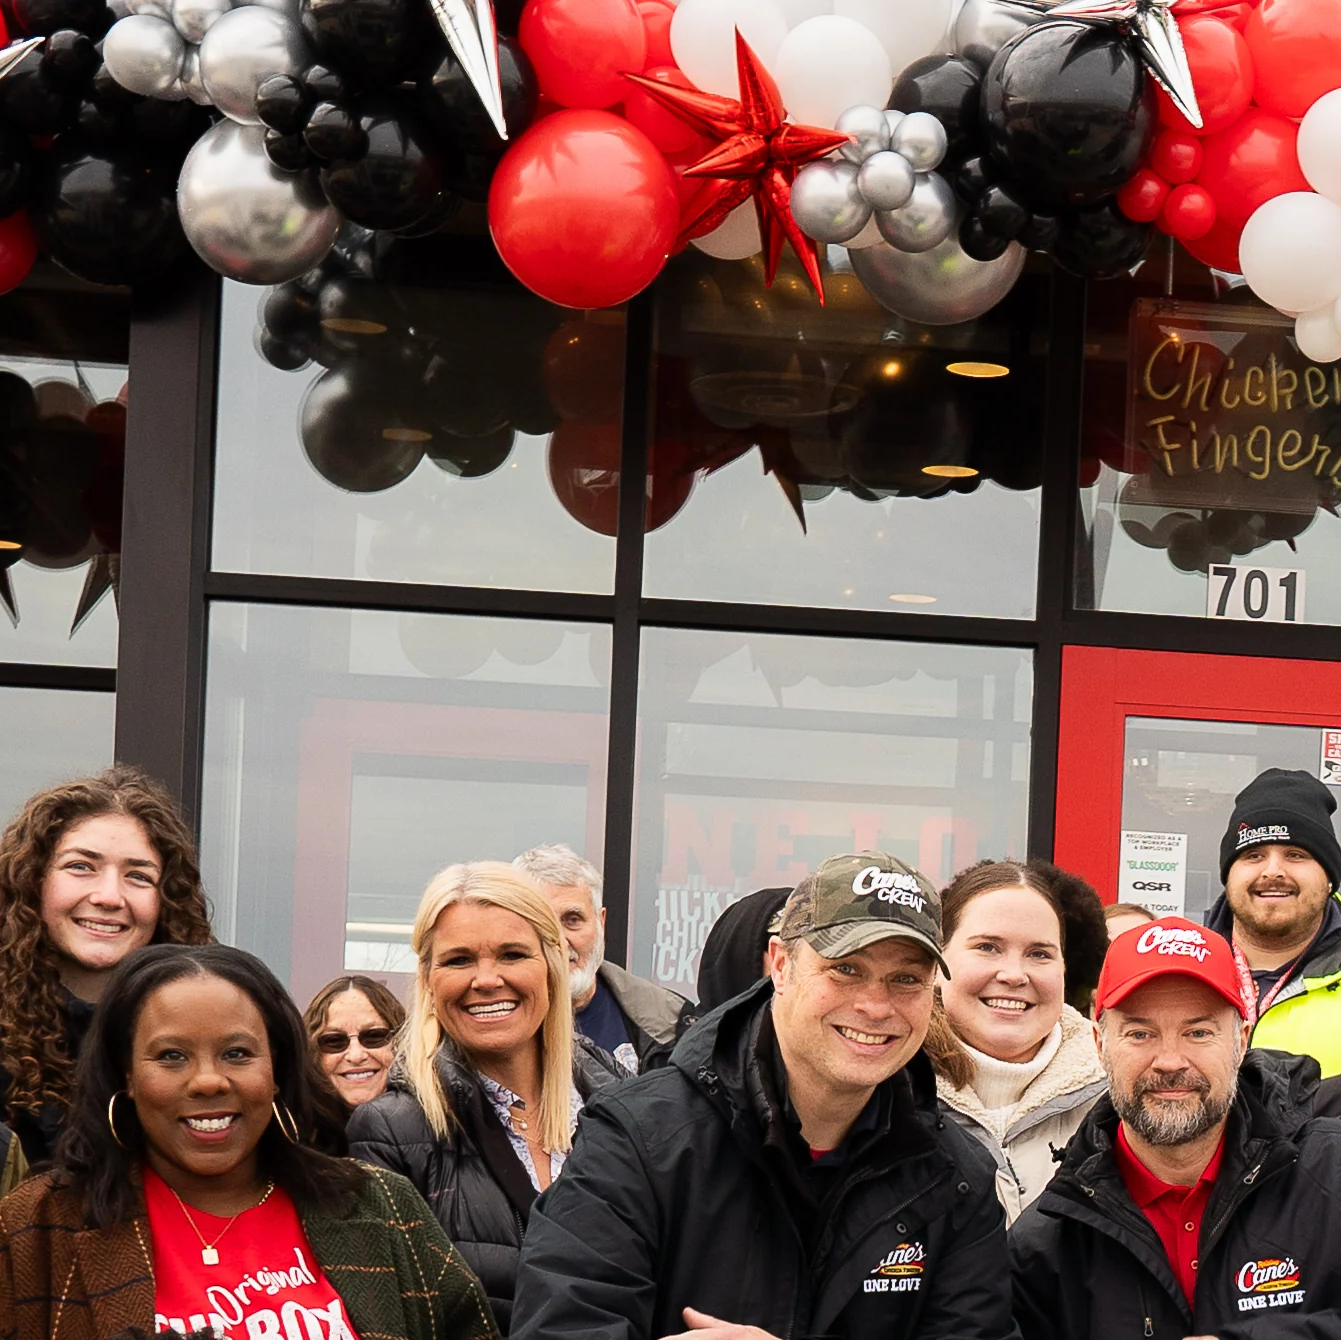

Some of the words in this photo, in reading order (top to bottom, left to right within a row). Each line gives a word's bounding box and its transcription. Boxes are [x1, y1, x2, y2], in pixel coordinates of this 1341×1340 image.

[1212, 566, 1298, 621] 701
[1268, 825, 1288, 834] PRO
[1132, 881, 1171, 891] QSR
[877, 887, 925, 913] CREW
[1158, 941, 1210, 962] CREW
[1238, 1257, 1299, 1292] Cane's
[207, 1247, 316, 1325] Original
[863, 1279, 889, 1293] ONE
[1238, 1295, 1267, 1311] ONE
[1268, 1291, 1303, 1307] LOVE
